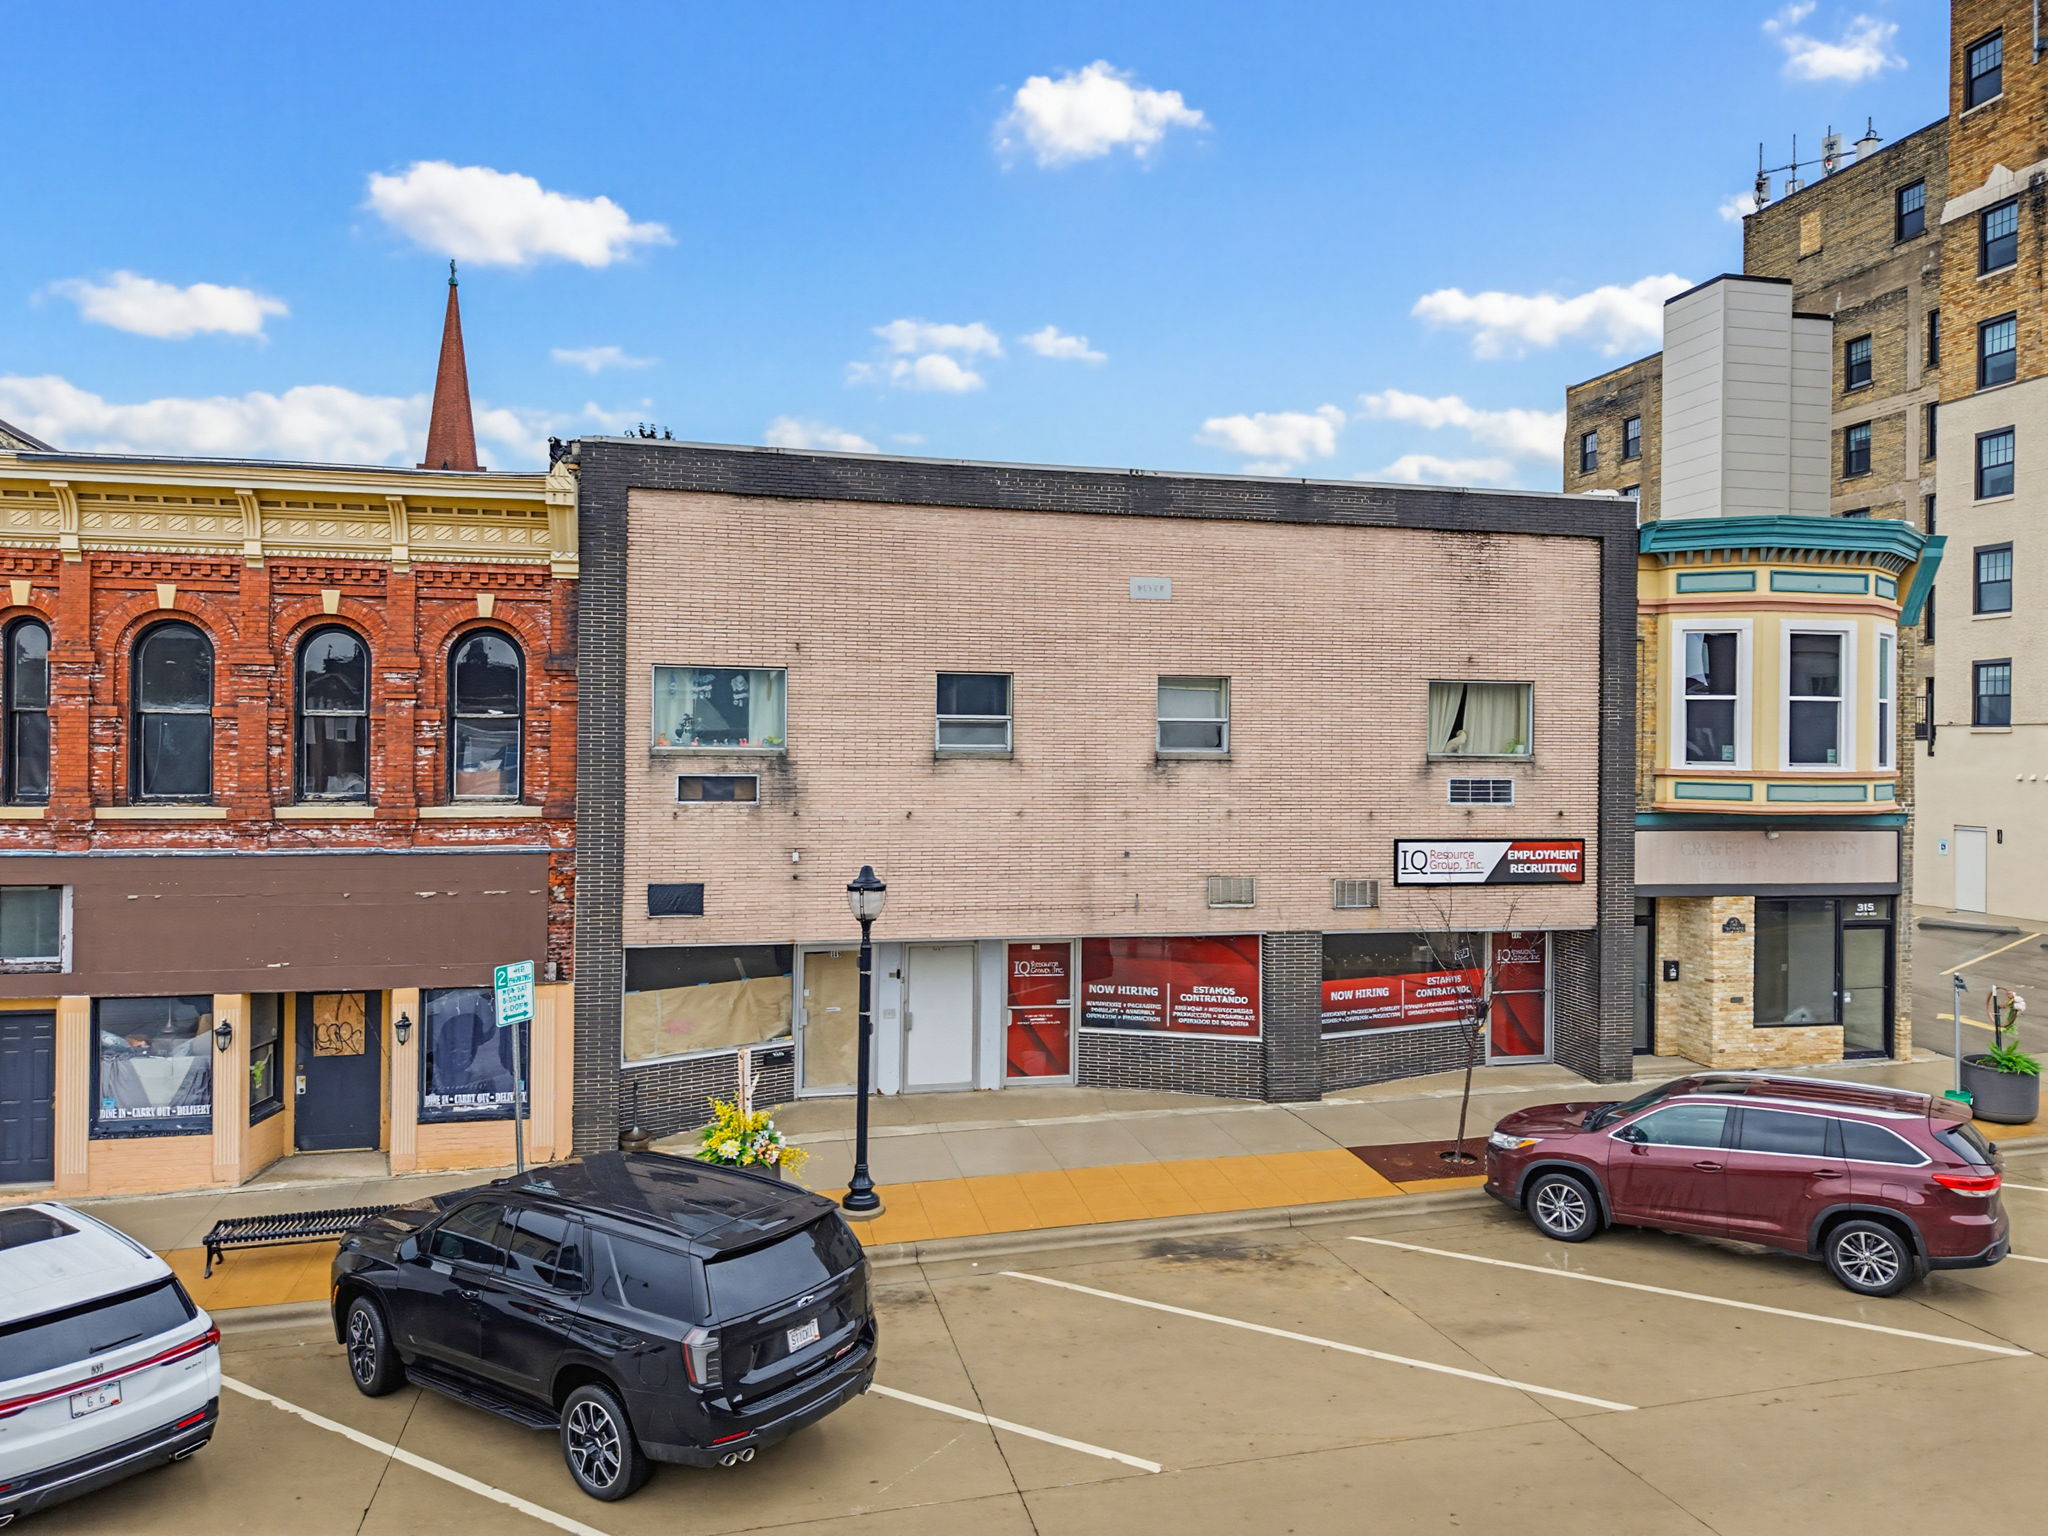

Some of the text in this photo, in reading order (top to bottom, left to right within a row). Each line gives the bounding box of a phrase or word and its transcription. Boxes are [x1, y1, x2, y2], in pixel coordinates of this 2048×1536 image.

[1430, 850, 1474, 860] Resource
[1507, 850, 1580, 860] EMPLOYMENT
[1401, 850, 1428, 875] IQ
[1430, 860, 1485, 871] Group, Inc.
[1510, 863, 1577, 873] RECRUITING
[1857, 903, 1874, 911] 315
[1497, 949, 1511, 963] IQ
[1014, 961, 1031, 977] IQ
[497, 971, 506, 986] 2
[1089, 984, 1159, 996] NOW HIRING
[1193, 986, 1236, 995] ESTAMOS
[1330, 987, 1390, 1000] NOW HIRING
[1180, 994, 1249, 1004] CONTRATANDO
[495, 1091, 528, 1103] DELIVY
[100, 1104, 211, 1119] DINE IN CARRY OUT DELIVERY
